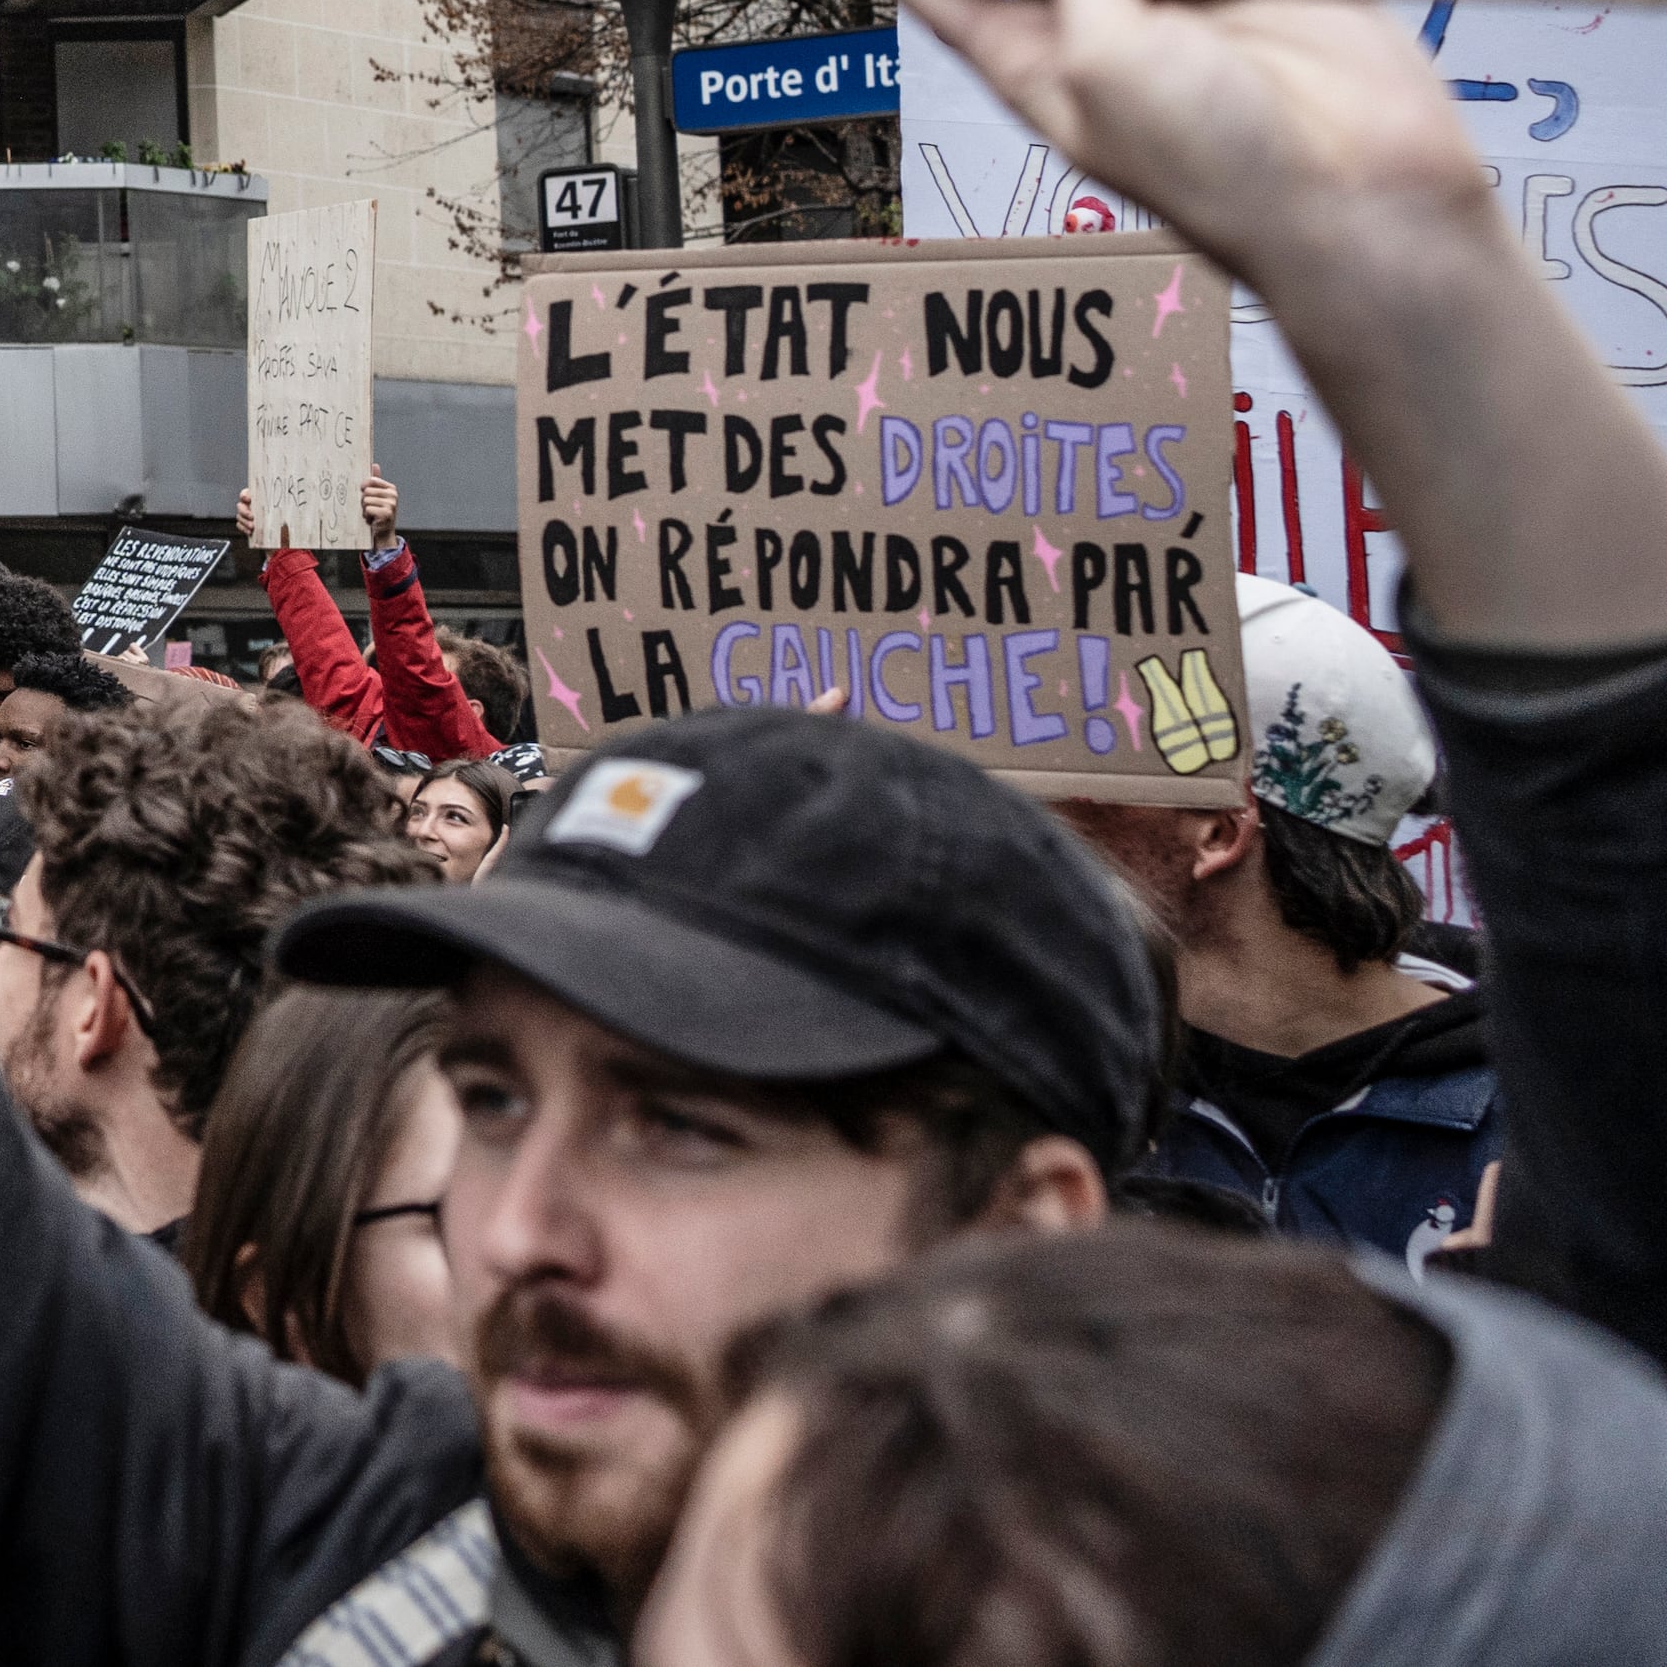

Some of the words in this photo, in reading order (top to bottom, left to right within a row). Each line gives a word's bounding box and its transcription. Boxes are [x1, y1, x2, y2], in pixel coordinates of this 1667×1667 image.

[700, 66, 804, 105] Porte
[815, 55, 849, 94] d'
[555, 178, 607, 219] 47
[546, 271, 870, 394] L'ÉTAT
[923, 287, 1117, 388] NOUS
[334, 411, 354, 448] CE
[535, 409, 708, 503] MET
[722, 412, 849, 500] DES
[113, 538, 141, 556] LES
[120, 559, 145, 571] SONT
[93, 567, 121, 583] ELLES
[119, 572, 144, 587] SONT
[540, 517, 619, 608] ON
[658, 507, 1032, 626] RÉPONDRA
[1071, 542, 1210, 636] PAR
[586, 628, 693, 723] LA
